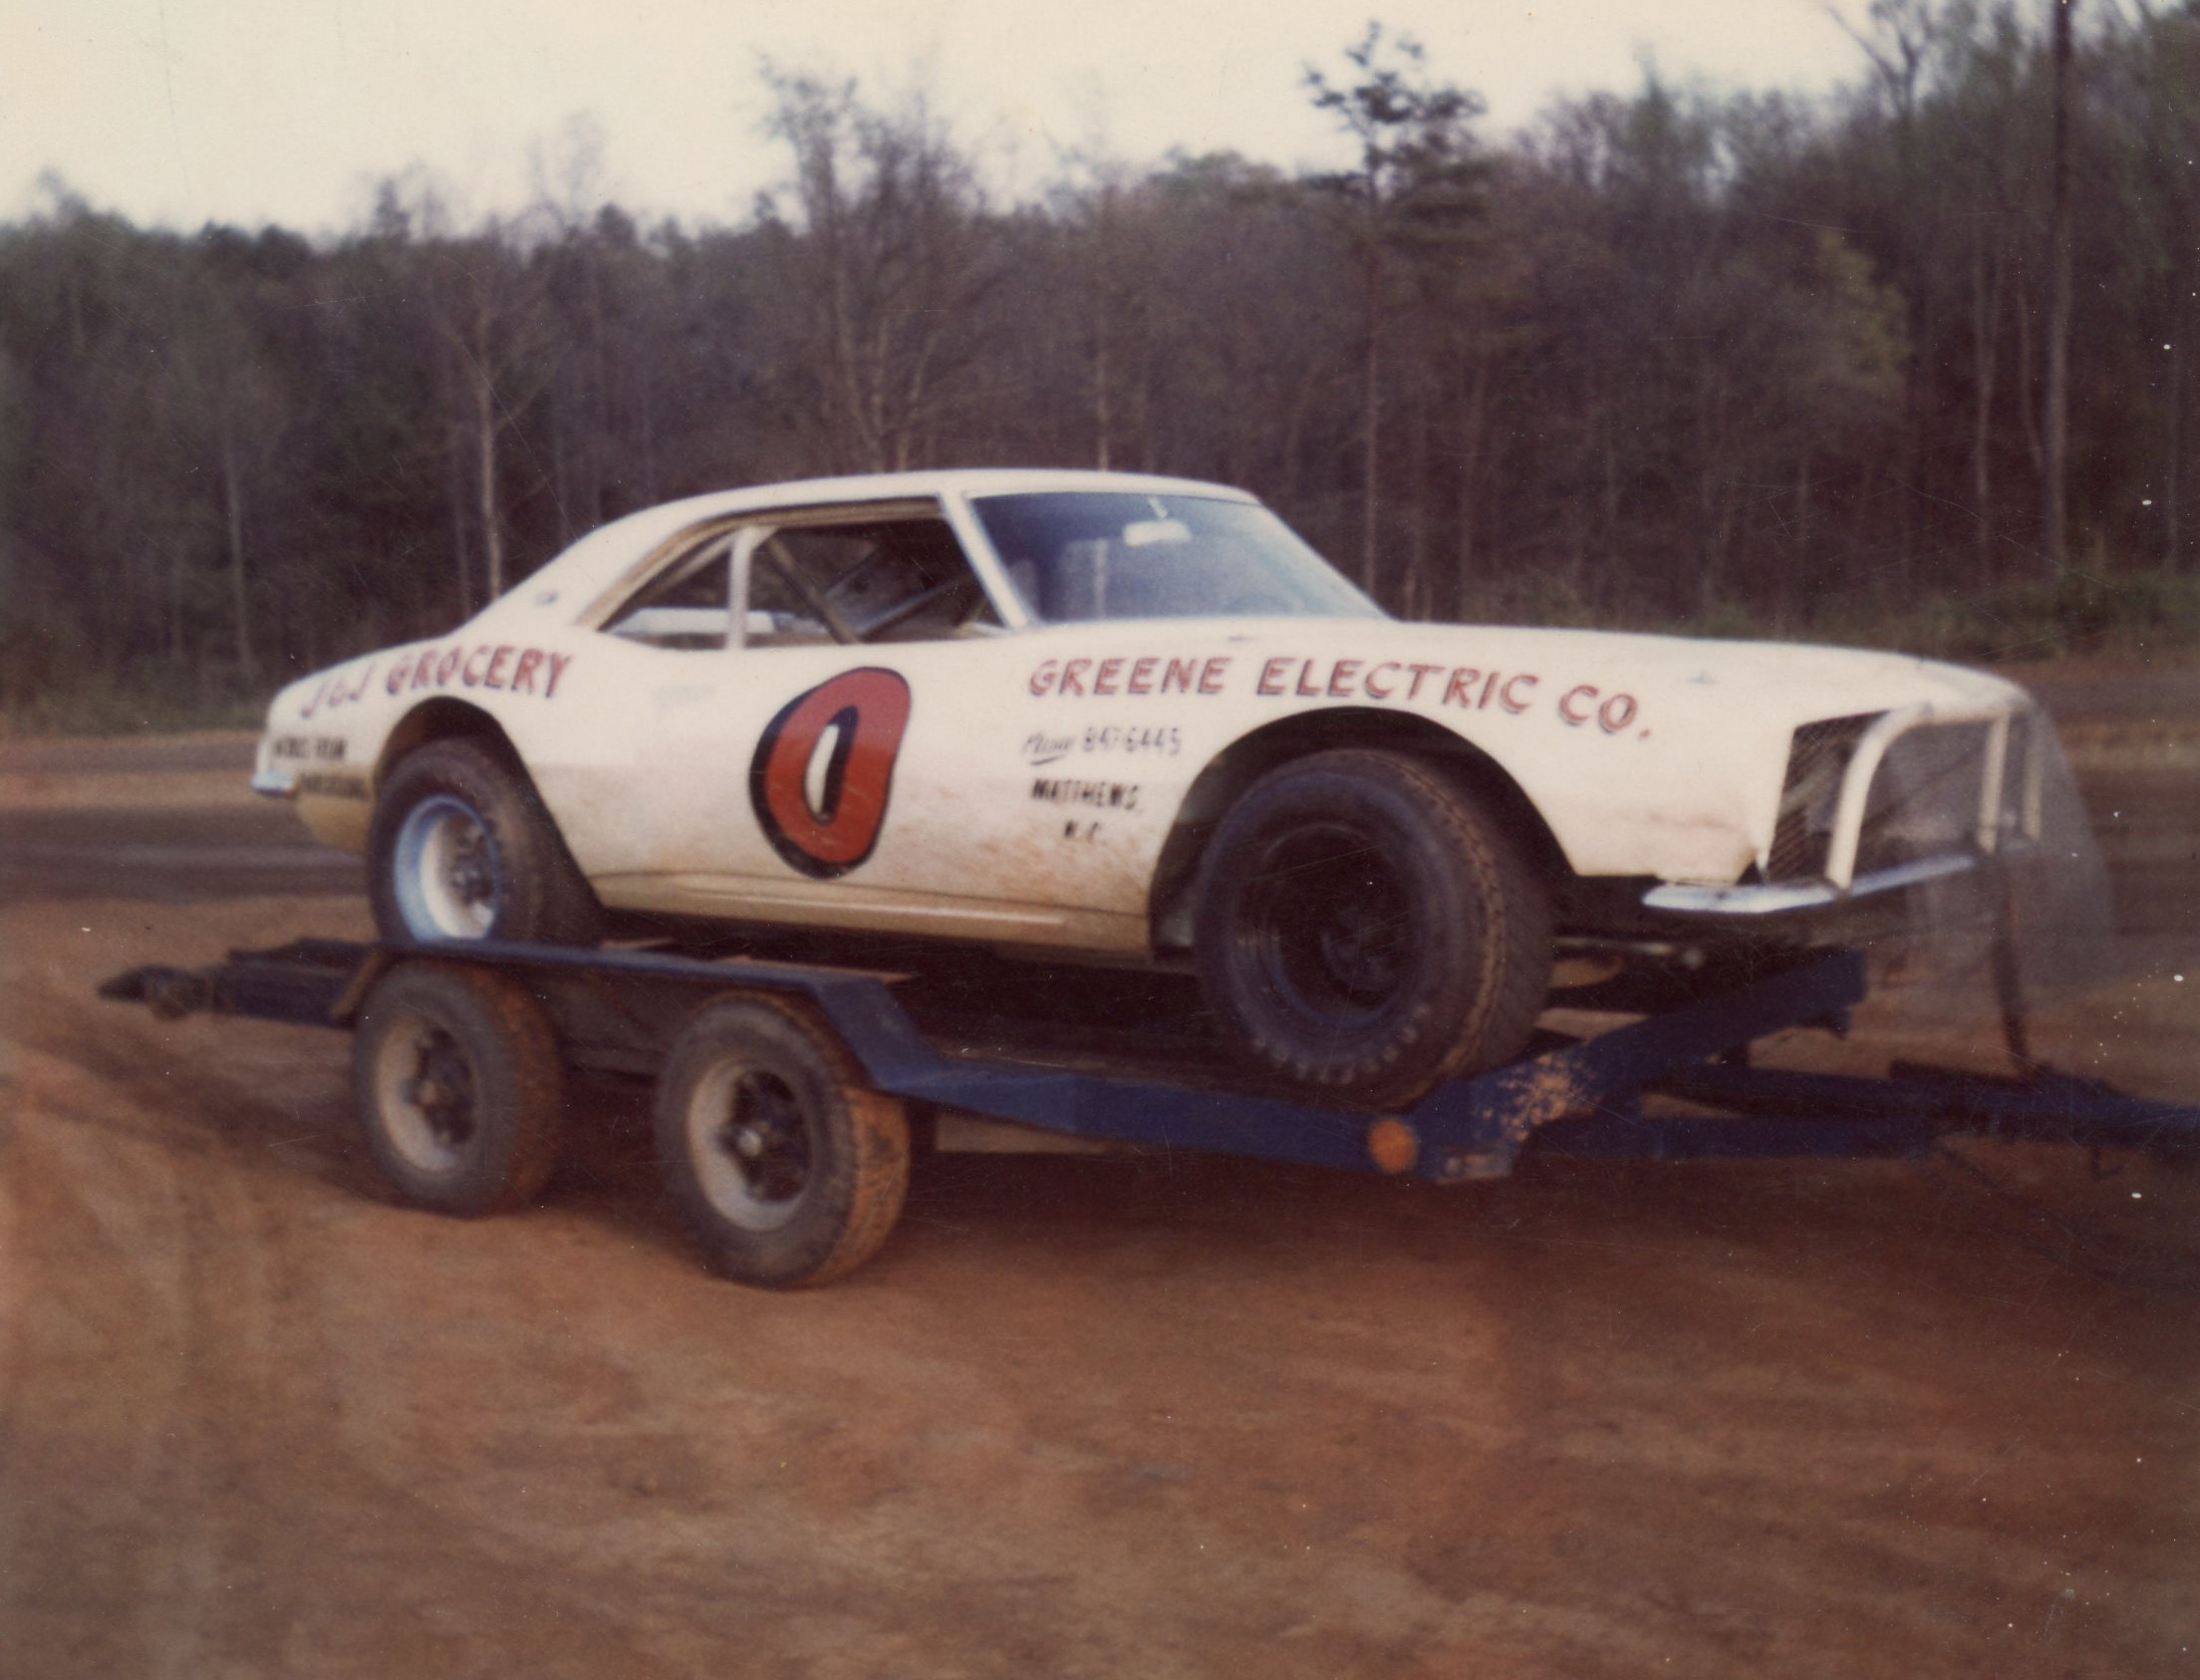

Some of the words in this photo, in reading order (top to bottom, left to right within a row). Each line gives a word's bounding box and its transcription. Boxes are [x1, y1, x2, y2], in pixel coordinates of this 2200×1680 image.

[386, 645, 573, 699] GROCERY
[1029, 656, 1231, 697] GREENE
[1256, 656, 1539, 713] ELECTRIC
[1557, 684, 1651, 741] CO.
[749, 666, 911, 881] 0
